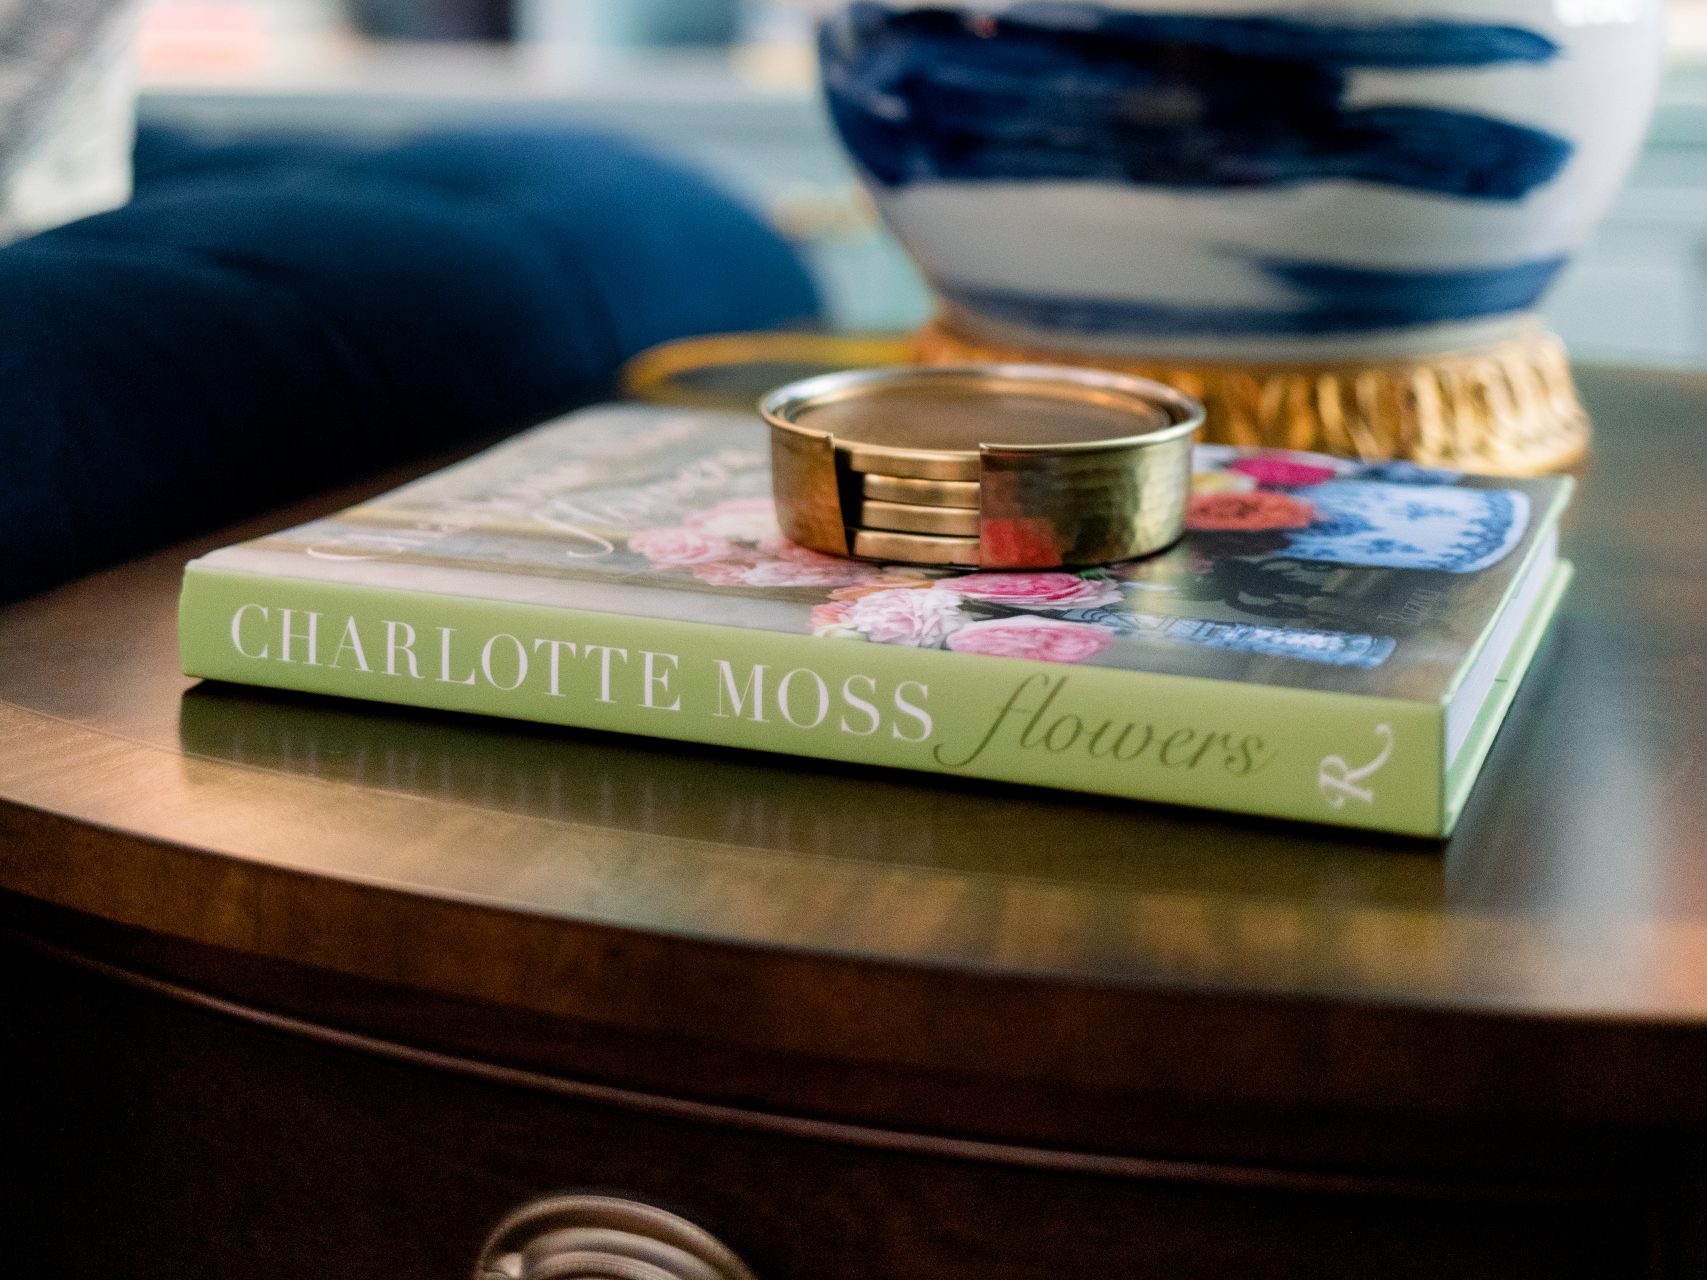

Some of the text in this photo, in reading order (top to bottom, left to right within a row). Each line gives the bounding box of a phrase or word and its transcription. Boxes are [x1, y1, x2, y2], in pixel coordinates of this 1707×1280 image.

[231, 603, 1274, 776] CHARLOTTE MOSS flowers
[1319, 723, 1393, 808] R
